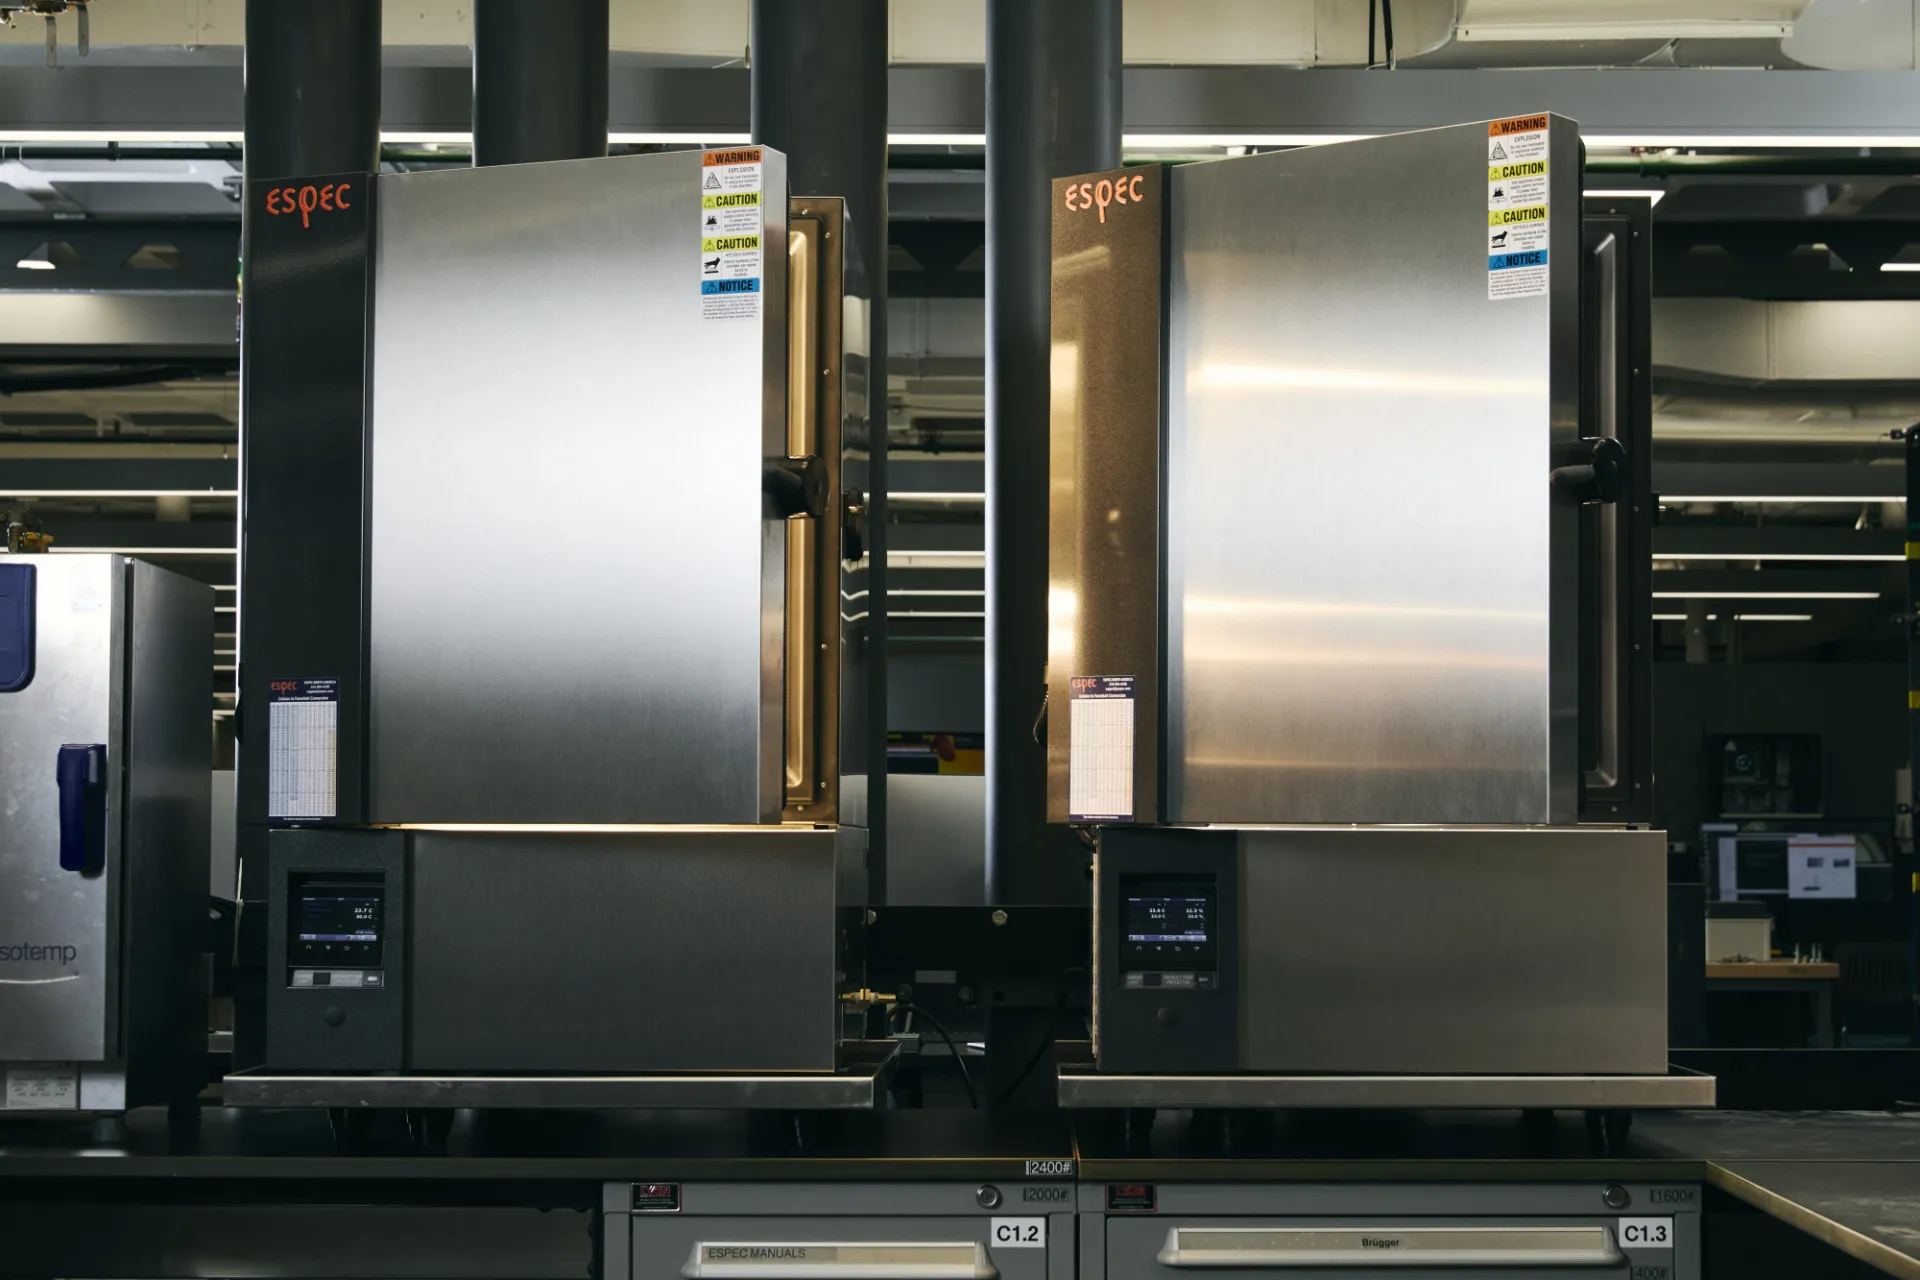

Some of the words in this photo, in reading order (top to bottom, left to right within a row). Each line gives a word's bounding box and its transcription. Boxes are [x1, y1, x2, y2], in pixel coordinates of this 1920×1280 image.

[1501, 117, 1546, 133] WARNING
[1514, 134, 1541, 142] EXPLOSION
[715, 150, 760, 164] WARNING
[1502, 162, 1544, 178] CAUTION
[716, 194, 758, 206] CAUTION
[1503, 208, 1545, 223] CAUTION
[716, 237, 758, 250] CAUTION
[1506, 252, 1541, 266] NOTICE
[719, 280, 753, 292] NOTICE
[0, 942, 76, 966] sotemp
[1031, 1161, 1070, 1174] 2400#
[1028, 1188, 1067, 1200] 2000#
[1656, 1189, 1694, 1202] 1600#
[996, 1225, 1038, 1242] C1.2
[1624, 1225, 1667, 1242] C1.3
[1361, 1238, 1400, 1248] Brügger
[708, 1248, 748, 1258] ESPEC
[750, 1248, 806, 1258] MANUALS
[1635, 1268, 1666, 1279] 400#
